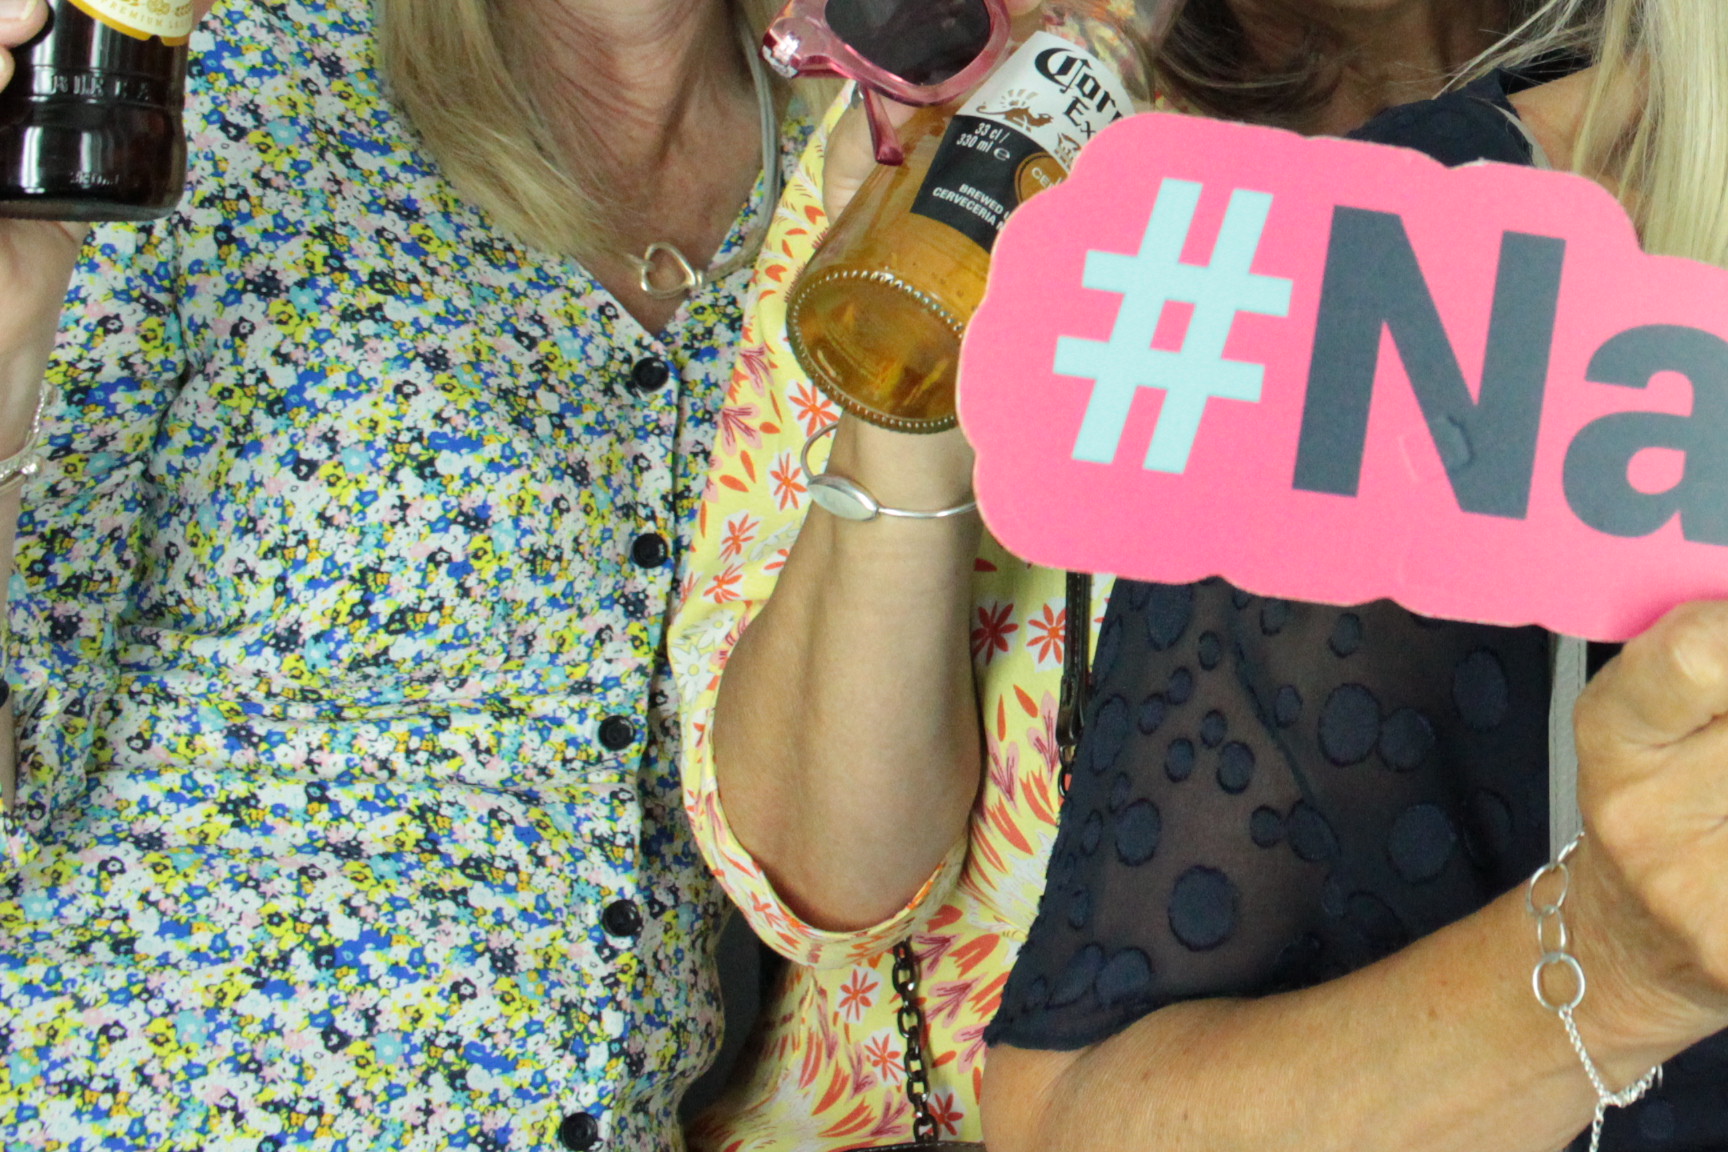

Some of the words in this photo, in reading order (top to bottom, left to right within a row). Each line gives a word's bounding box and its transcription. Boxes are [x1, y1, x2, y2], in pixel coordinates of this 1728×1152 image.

[974, 122, 990, 137] 33
[956, 133, 977, 148] 330
[976, 139, 994, 154] ml
[932, 187, 995, 225] CERVECERIA
[958, 183, 1004, 215] BREWED
